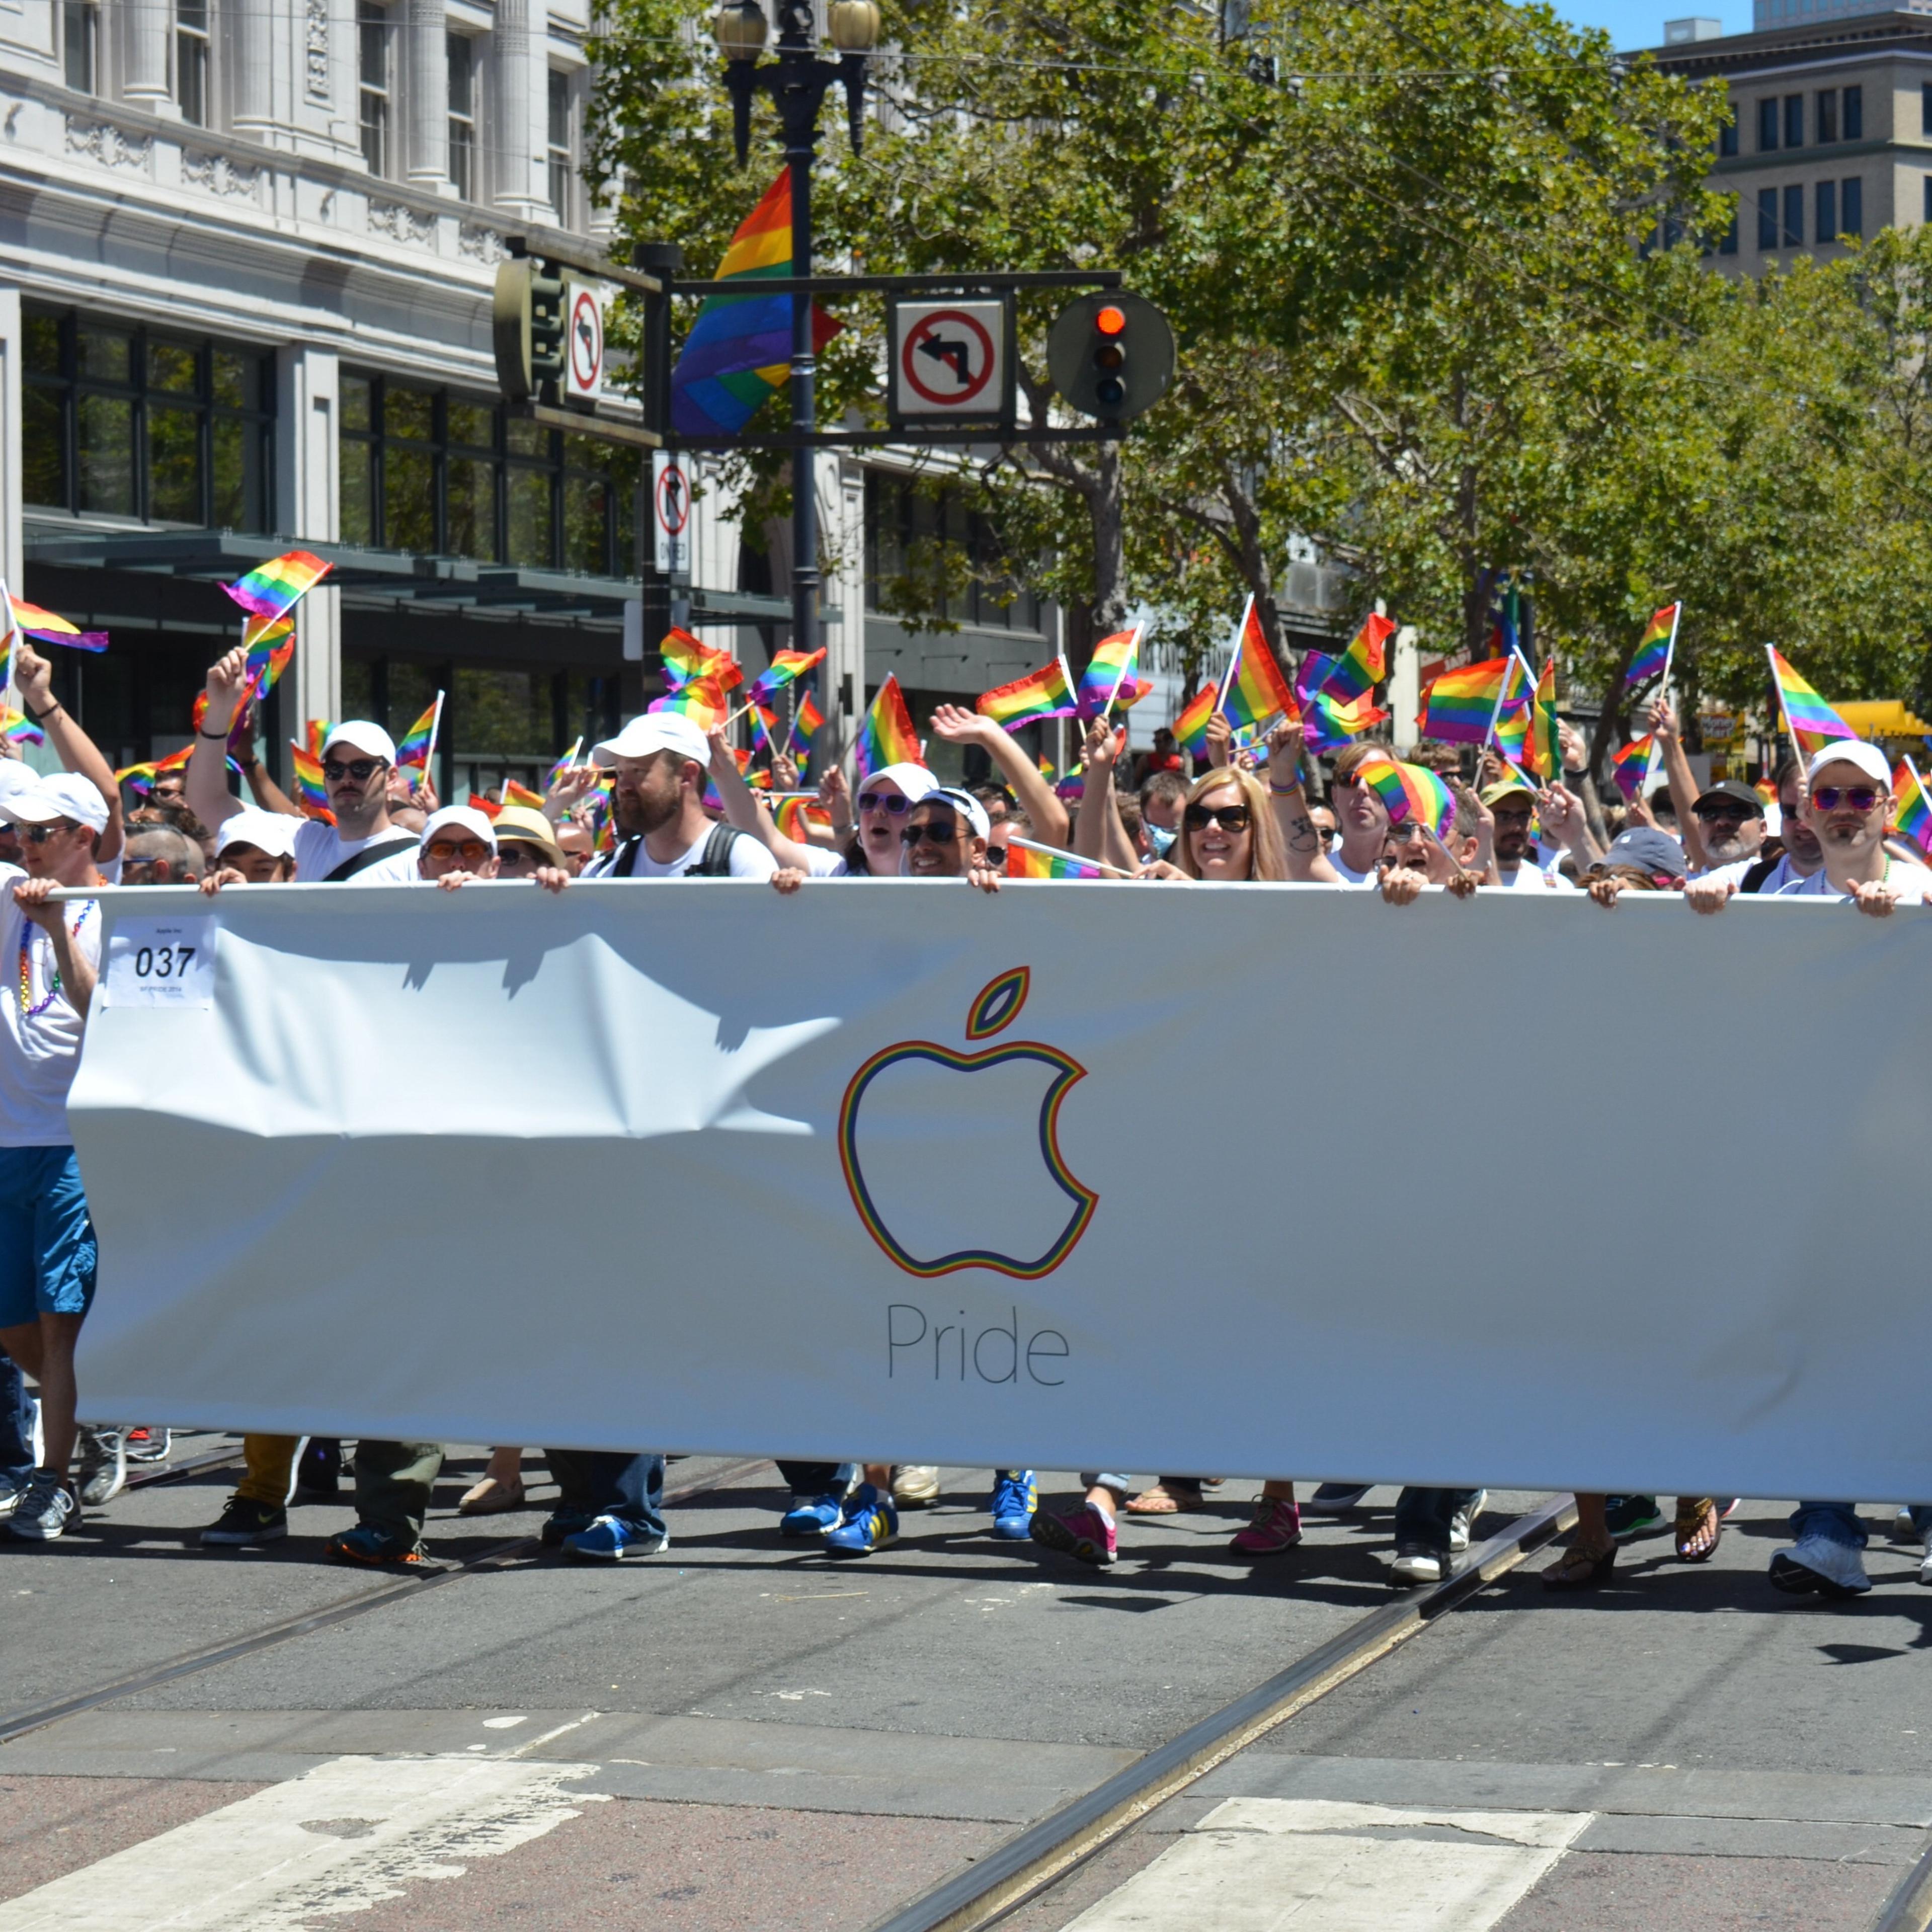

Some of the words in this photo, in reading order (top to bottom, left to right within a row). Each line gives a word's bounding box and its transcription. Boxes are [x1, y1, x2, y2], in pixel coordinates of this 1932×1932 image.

[1701, 715, 1737, 731] Money
[1704, 727, 1733, 739] Mart
[136, 947, 196, 978] 037
[888, 1304, 1070, 1386] Pride
